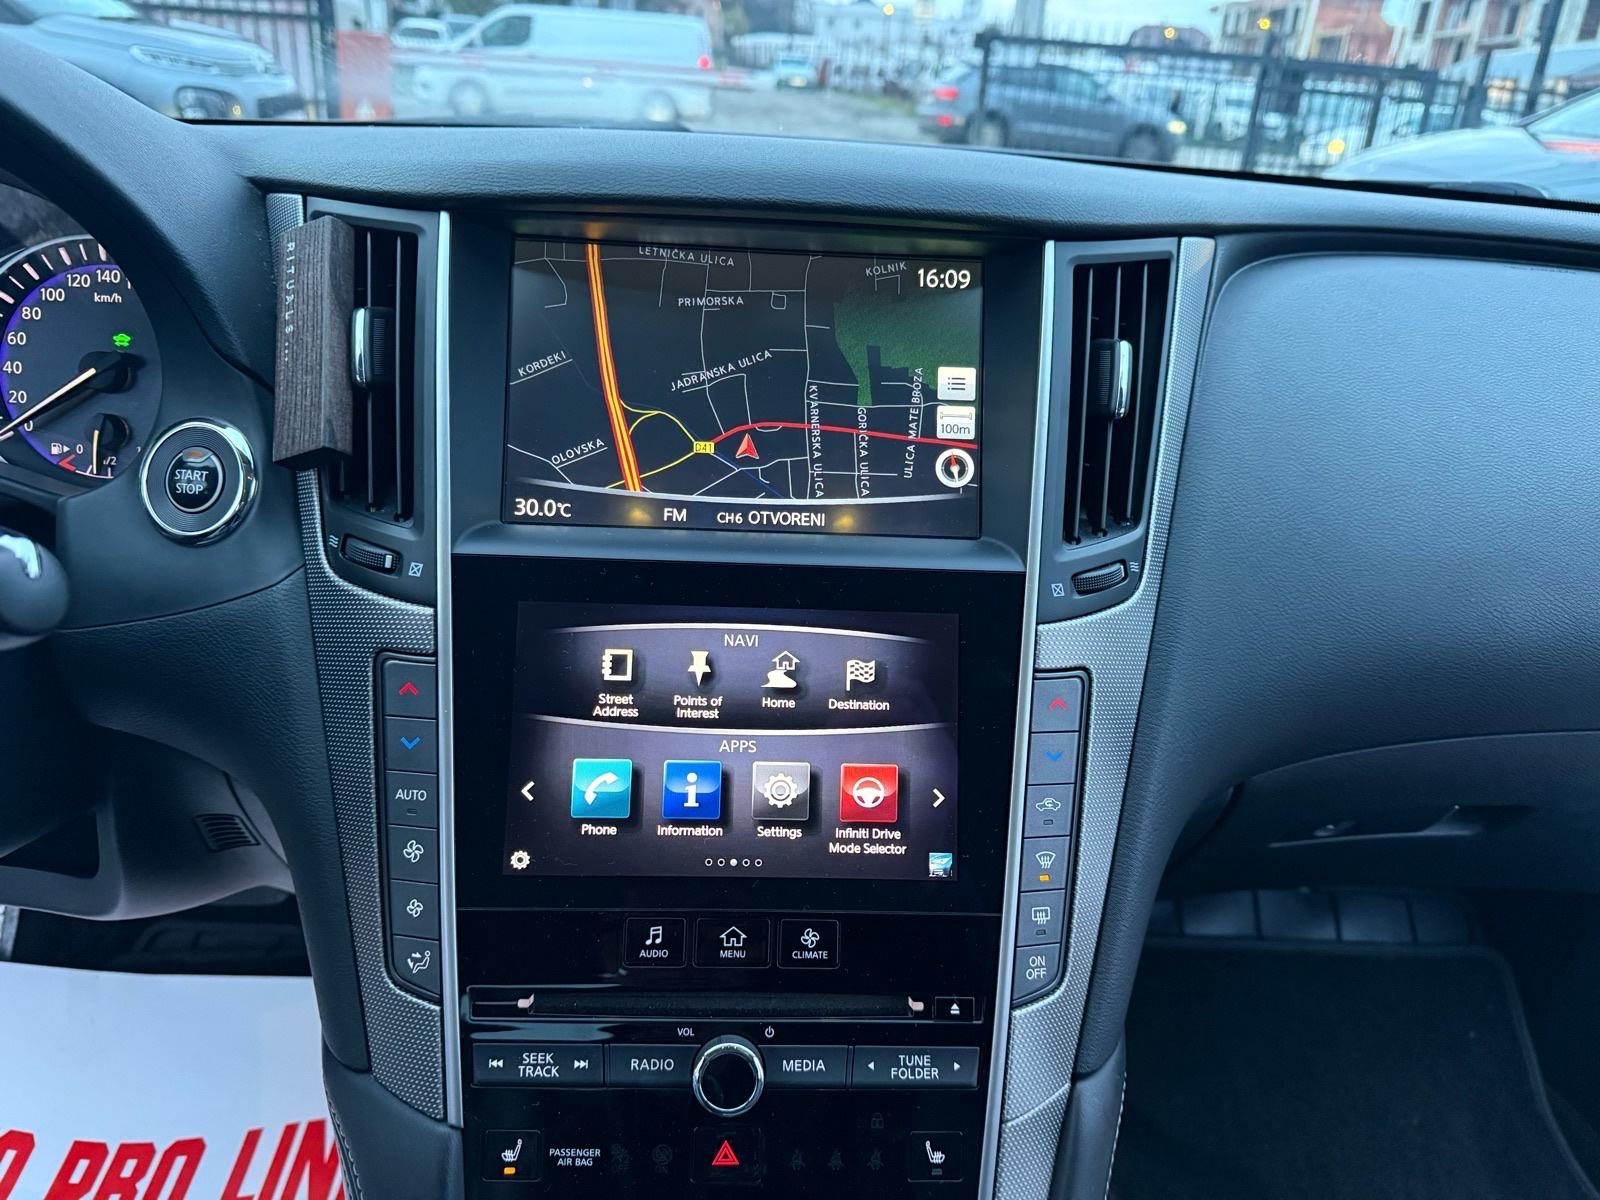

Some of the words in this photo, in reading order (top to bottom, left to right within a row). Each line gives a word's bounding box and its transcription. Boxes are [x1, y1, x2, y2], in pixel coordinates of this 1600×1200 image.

[700, 252, 735, 266] ULICA
[865, 261, 907, 277] KOLNIK
[66, 274, 91, 288] 120
[96, 269, 121, 283] 140
[917, 267, 971, 289] 16:09
[40, 288, 65, 302] 100
[94, 292, 122, 303] km/h
[678, 296, 744, 308] PRIMORSKA
[21, 306, 42, 320] 80
[7, 331, 27, 345] 60
[2, 360, 22, 374] 40
[517, 350, 567, 377] KORDEKI
[671, 362, 736, 392] JADRANSKA
[738, 349, 773, 369] ULICA
[911, 367, 924, 404] BROZA
[8, 390, 27, 404] 20
[808, 384, 822, 459] KVARNERSKA
[908, 406, 919, 439] MATE
[940, 423, 971, 434] 100m
[76, 444, 84, 455] 0
[551, 438, 605, 466] OLOVSKA
[695, 443, 713, 453] D41
[903, 444, 916, 479] ULICA
[174, 469, 209, 481] START
[813, 463, 824, 498] ULICA
[859, 462, 870, 497] ULICA
[175, 482, 204, 495] STOP
[663, 507, 687, 522] FM
[717, 511, 743, 524] CH6
[748, 510, 825, 527] OTVORENI
[724, 633, 759, 648] NAVI
[598, 693, 634, 705] Street
[674, 694, 708, 707] Points
[710, 695, 723, 707] of
[762, 696, 796, 708] Home
[828, 698, 890, 711] Destination
[593, 706, 639, 718] Address
[676, 707, 719, 719] Interest
[719, 740, 757, 753] APPS
[395, 788, 427, 801] AUTO
[581, 823, 618, 836] Phone
[657, 824, 723, 837] Information
[757, 826, 802, 840] Settings
[835, 827, 870, 839] Infiniti
[872, 828, 901, 840] Drive
[829, 842, 861, 854] Mode
[863, 842, 907, 855] Selector
[639, 949, 669, 958] AUDIO
[719, 950, 746, 959] MENU
[792, 950, 829, 960] CLIMATE
[1029, 956, 1046, 968] ON
[1026, 967, 1047, 980] OFF
[677, 1027, 695, 1037] VOL
[522, 1052, 554, 1064] SEEK
[898, 1055, 931, 1066] TUNE
[518, 1065, 559, 1078] TRACK
[630, 1058, 675, 1072] RADIO
[782, 1059, 826, 1072] MEDIA
[891, 1067, 939, 1080] FOLDER
[549, 1148, 601, 1157] PASSENGER
[557, 1157, 573, 1167] AIR
[575, 1157, 593, 1167] BAG
